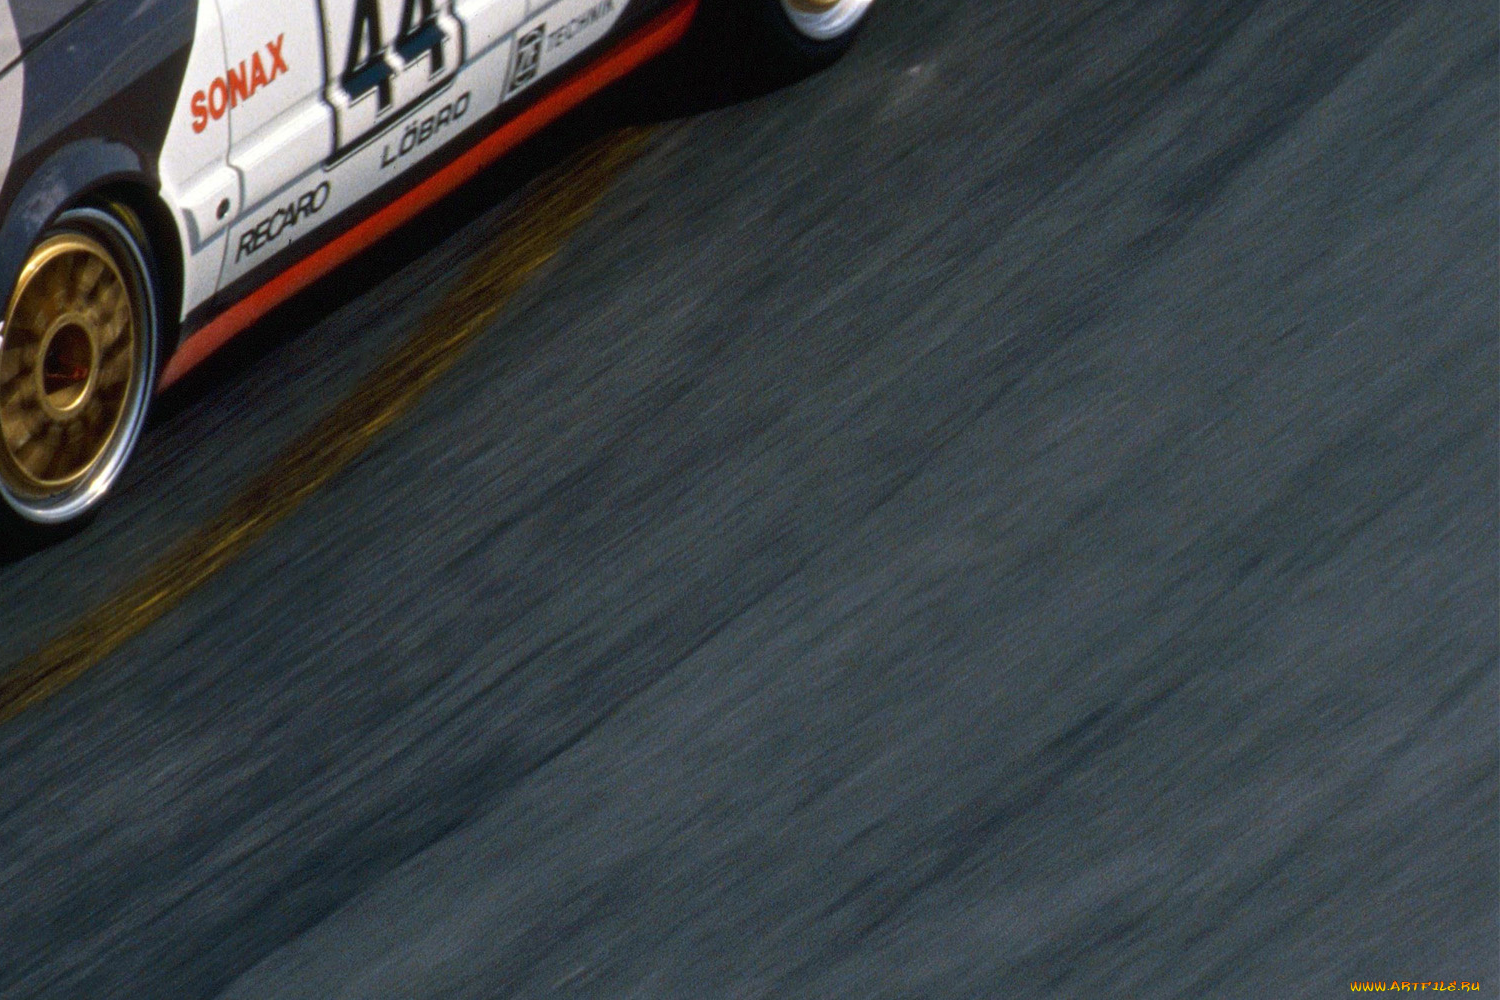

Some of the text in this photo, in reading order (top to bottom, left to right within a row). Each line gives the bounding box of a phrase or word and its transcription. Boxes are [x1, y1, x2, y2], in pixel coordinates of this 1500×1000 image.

[190, 33, 289, 134] SONAX
[380, 91, 471, 169] LÖBRO
[234, 180, 331, 264] RECARO
